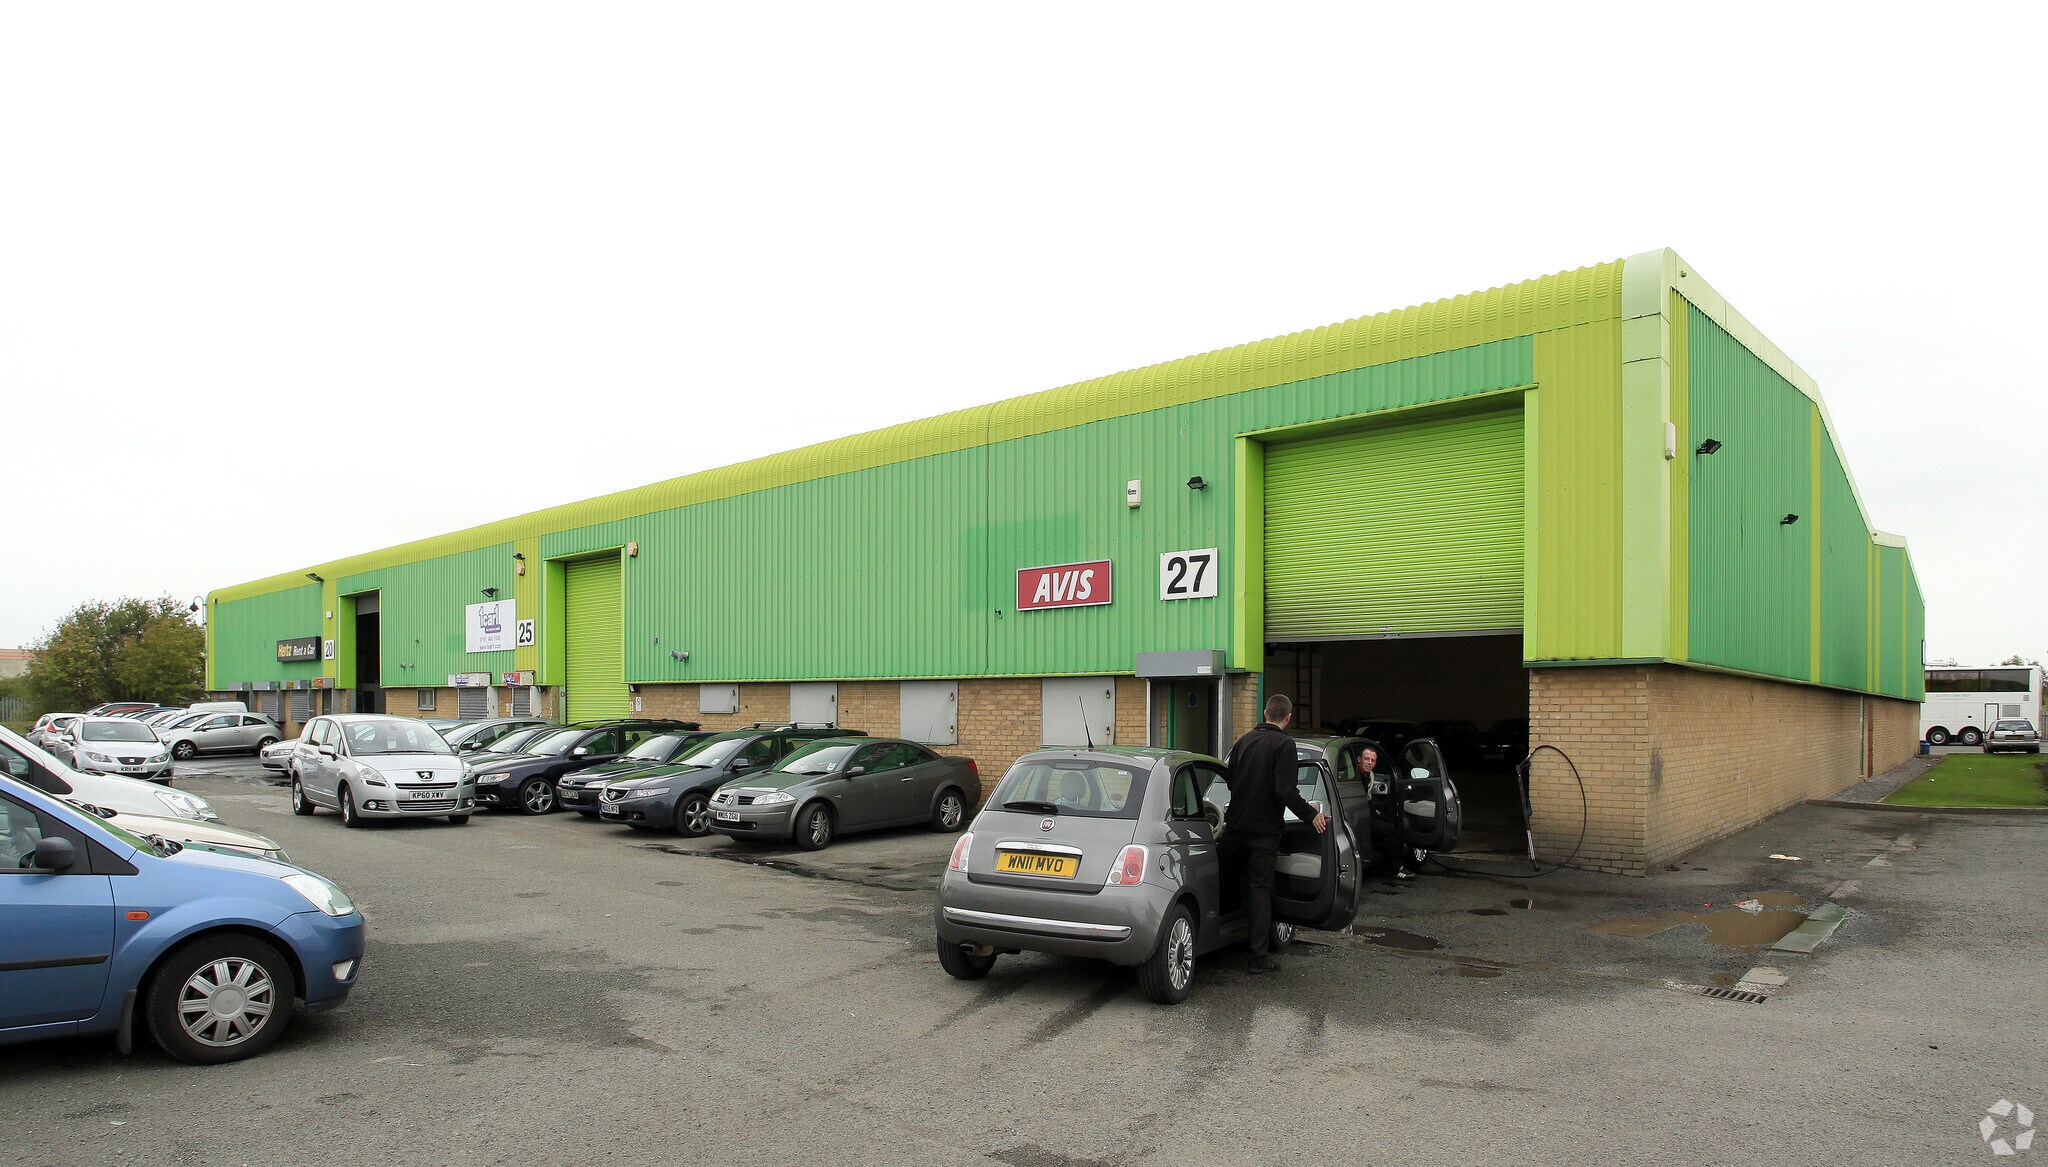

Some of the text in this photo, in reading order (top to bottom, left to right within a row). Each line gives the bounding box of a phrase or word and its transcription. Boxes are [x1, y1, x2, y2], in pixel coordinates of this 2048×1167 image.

[1167, 554, 1211, 594] 27
[1032, 569, 1095, 603] AVIS
[519, 622, 532, 643] 25
[278, 643, 316, 657] Hertz Rent a Car
[325, 642, 333, 657] 20
[1008, 855, 1064, 872] WN11 MVO
